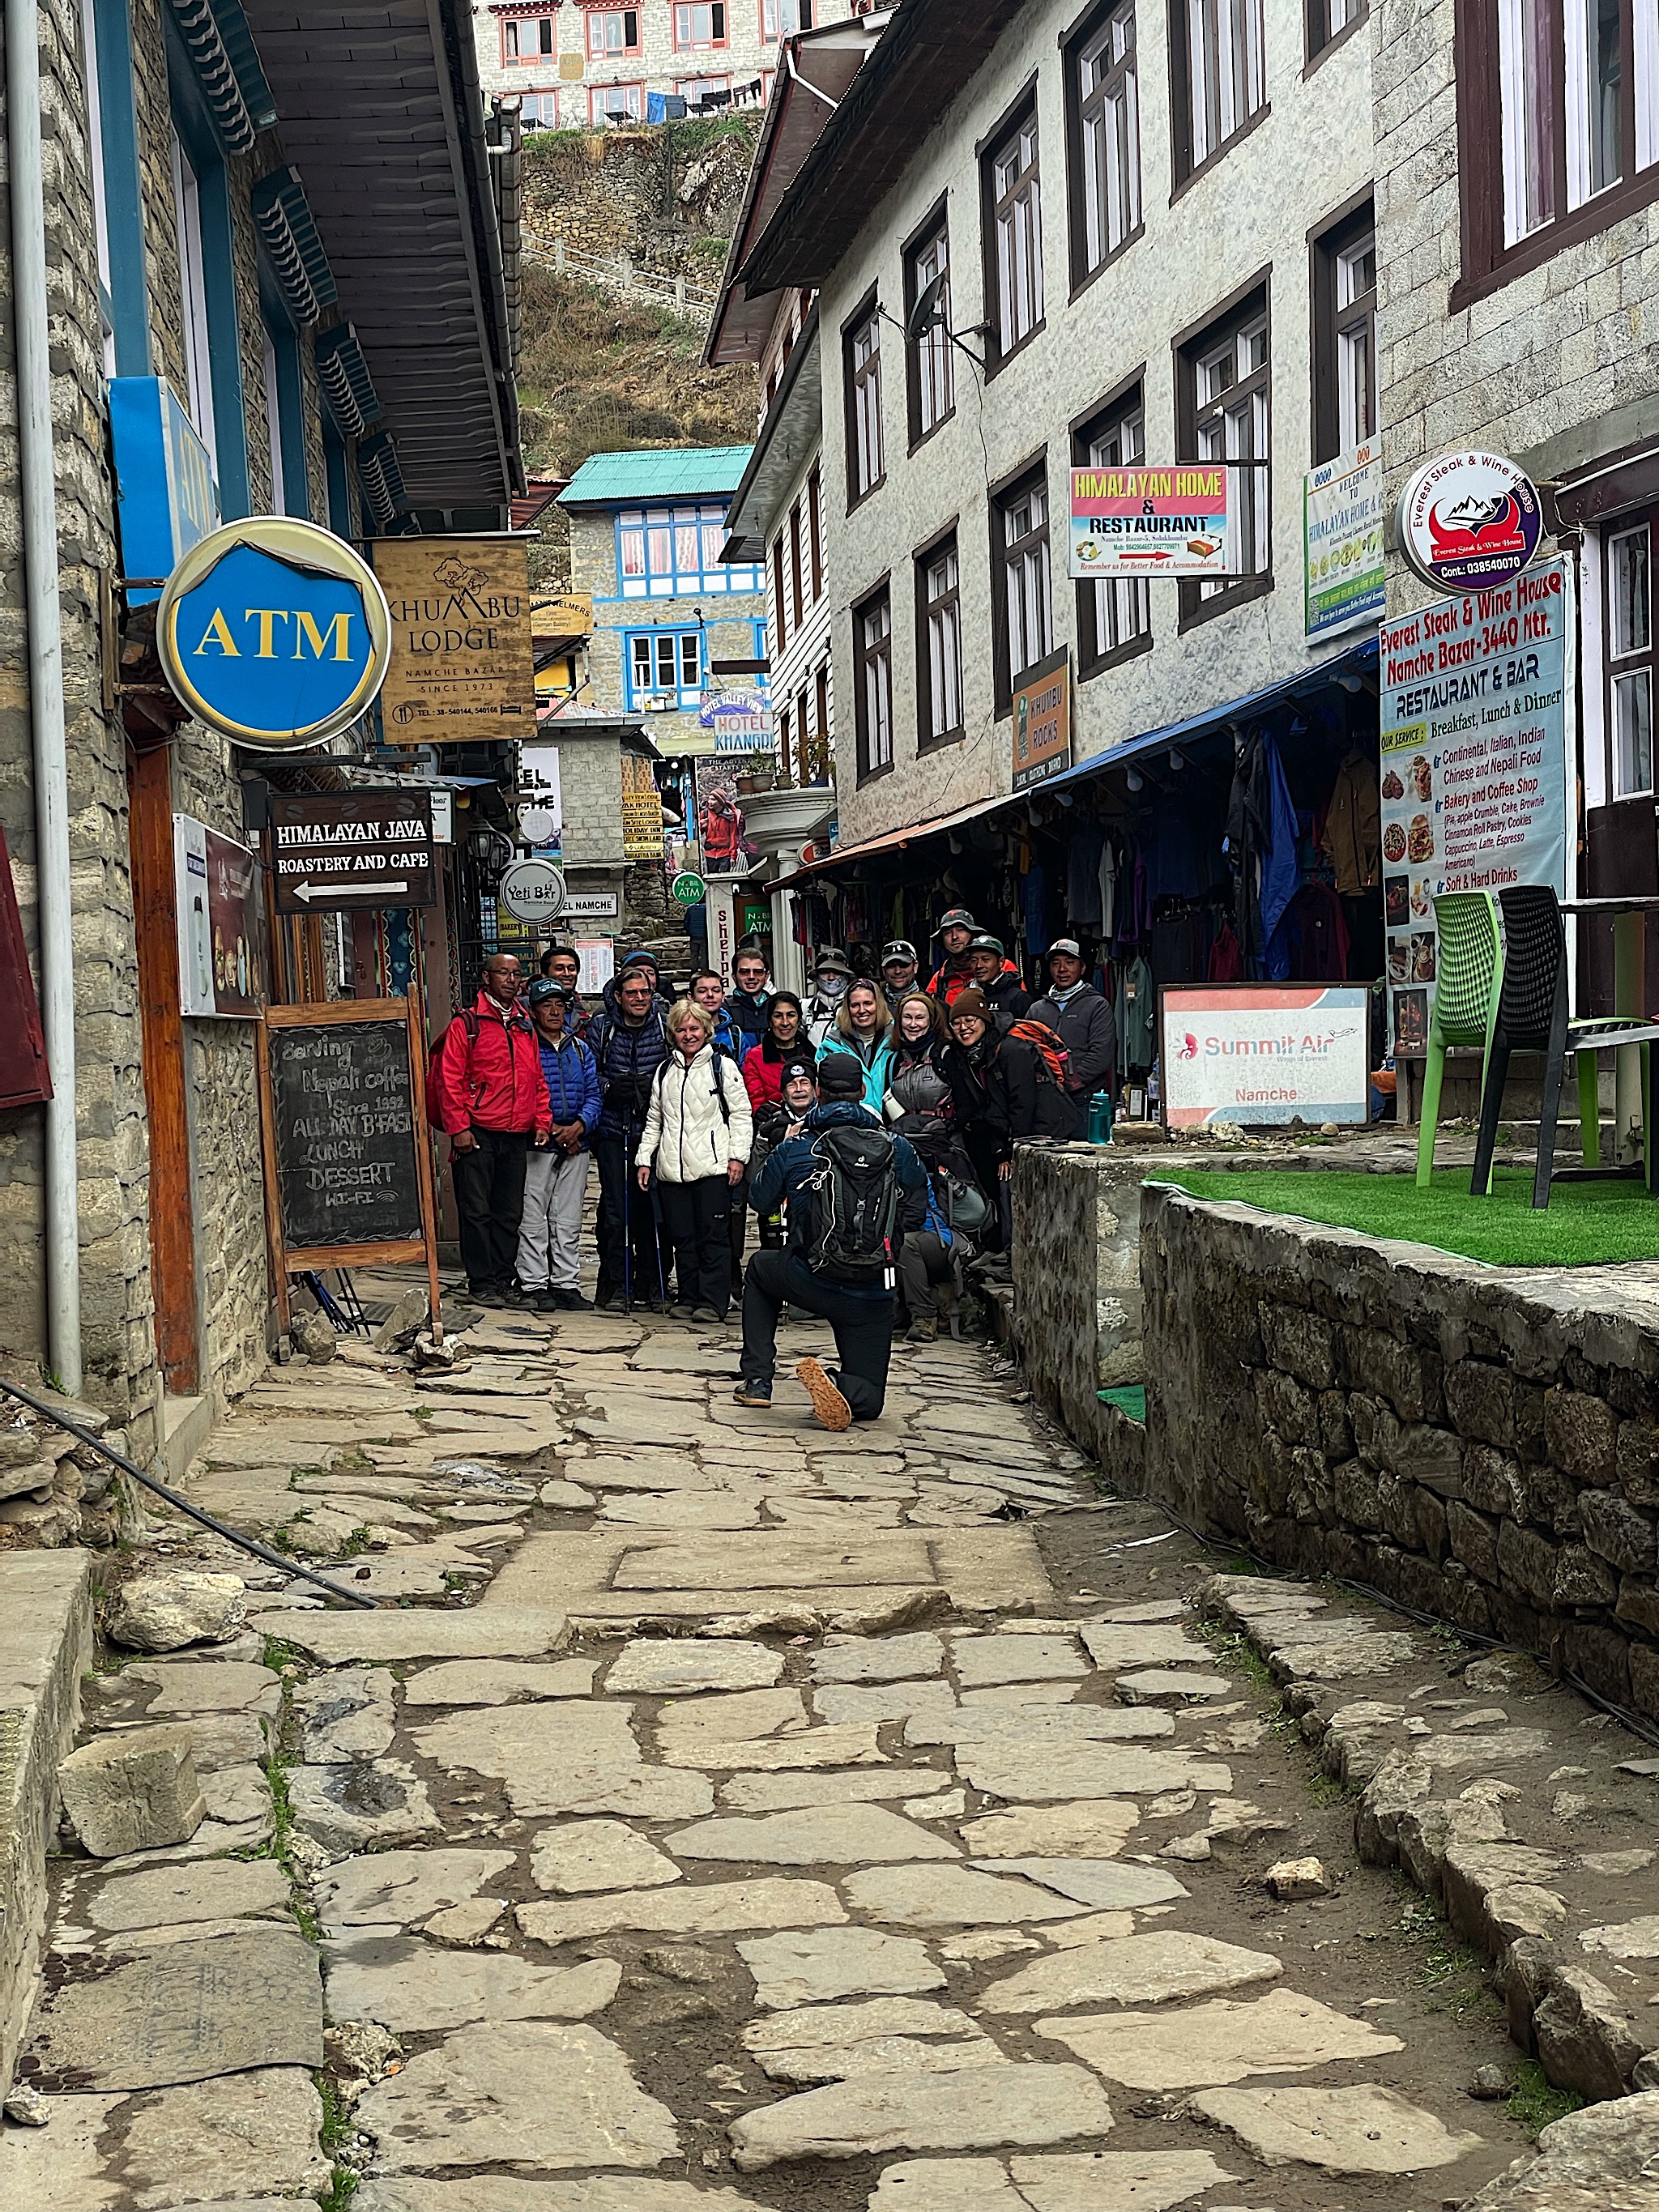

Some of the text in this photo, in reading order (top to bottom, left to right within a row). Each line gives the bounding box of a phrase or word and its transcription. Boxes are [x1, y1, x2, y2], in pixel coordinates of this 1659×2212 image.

[1075, 471, 1222, 498] HIMALAYAN HOME
[1339, 467, 1369, 492] WELCOME
[1414, 455, 1534, 527] Everest Steak & Wine House
[1350, 487, 1358, 500] TO
[1142, 499, 1155, 515] &
[1309, 509, 1350, 543] HIMALAYAN
[1350, 498, 1369, 523] HOME
[1371, 495, 1375, 512] &
[1090, 516, 1209, 534] RESTAURANT
[1433, 548, 1456, 556] Everest
[1457, 544, 1476, 555] Steak
[1483, 541, 1501, 549] Wine
[1502, 539, 1522, 547] House
[1080, 562, 1111, 570] Remember
[1120, 561, 1129, 571] for
[1130, 561, 1149, 569] Better
[1149, 560, 1164, 569] Food
[1172, 560, 1218, 569] Accommodation
[1441, 556, 1520, 578] Cont.: 038540070
[388, 587, 520, 622] KHUMBU
[555, 599, 591, 617] ELMERS
[1381, 617, 1420, 657] Everest
[1423, 603, 1458, 640] Steak
[1462, 597, 1473, 628] &
[1477, 589, 1512, 621] Wine
[1516, 571, 1562, 612] House
[192, 607, 356, 662] ATM
[409, 628, 498, 653] LODGE
[1386, 609, 1552, 687] Namche Bazar-3440 Mtr.
[406, 668, 458, 677] NAMCHE
[420, 683, 493, 693] SINCE 1973
[1396, 653, 1541, 720] RESTAURANT & BAR
[700, 693, 764, 719] HOTEL VALLEY VIEW
[1030, 683, 1063, 720] KHUMBU
[718, 715, 770, 731] HOTEL
[1431, 689, 1562, 739] Breakfast, Lunch & Dinner
[715, 733, 774, 751] KHANGRI
[1033, 719, 1058, 750] ROCKS
[1381, 735, 1393, 750] OUR
[1442, 727, 1546, 765] Continental, Italian, Indian
[1444, 748, 1542, 786] Chinese and Nepali Food
[1444, 777, 1538, 811] Bakery and Coffee Shop
[1474, 804, 1500, 820] Crumble,
[1501, 799, 1519, 814] Cake,
[1520, 795, 1545, 811] Brownie
[276, 820, 427, 844] HIMALAYAN JAVA
[1444, 813, 1532, 841] Cinnamon Roll Pastry, Cookies
[1444, 833, 1525, 857] Cappuccino, Latte, Espresso
[278, 852, 429, 874] ROASTERY AND CAFE
[1444, 855, 1476, 871] Americano)
[1446, 867, 1518, 892] Soft & Hard Drinks
[507, 884, 531, 900] Yeti
[678, 888, 700, 897] ATM
[575, 901, 612, 910] NAMCHE
[749, 921, 772, 933] ATM
[282, 1034, 353, 1070] Serving
[1205, 1034, 1335, 1056] Summit Air
[301, 1067, 360, 1108] Nepali
[1235, 1088, 1298, 1102] Namche
[292, 1117, 324, 1138] ALL
[328, 1115, 357, 1136] DAY
[299, 1140, 365, 1165] LUNCH
[305, 1161, 396, 1191] DESSERT
[325, 1191, 374, 1207] WI-FI
